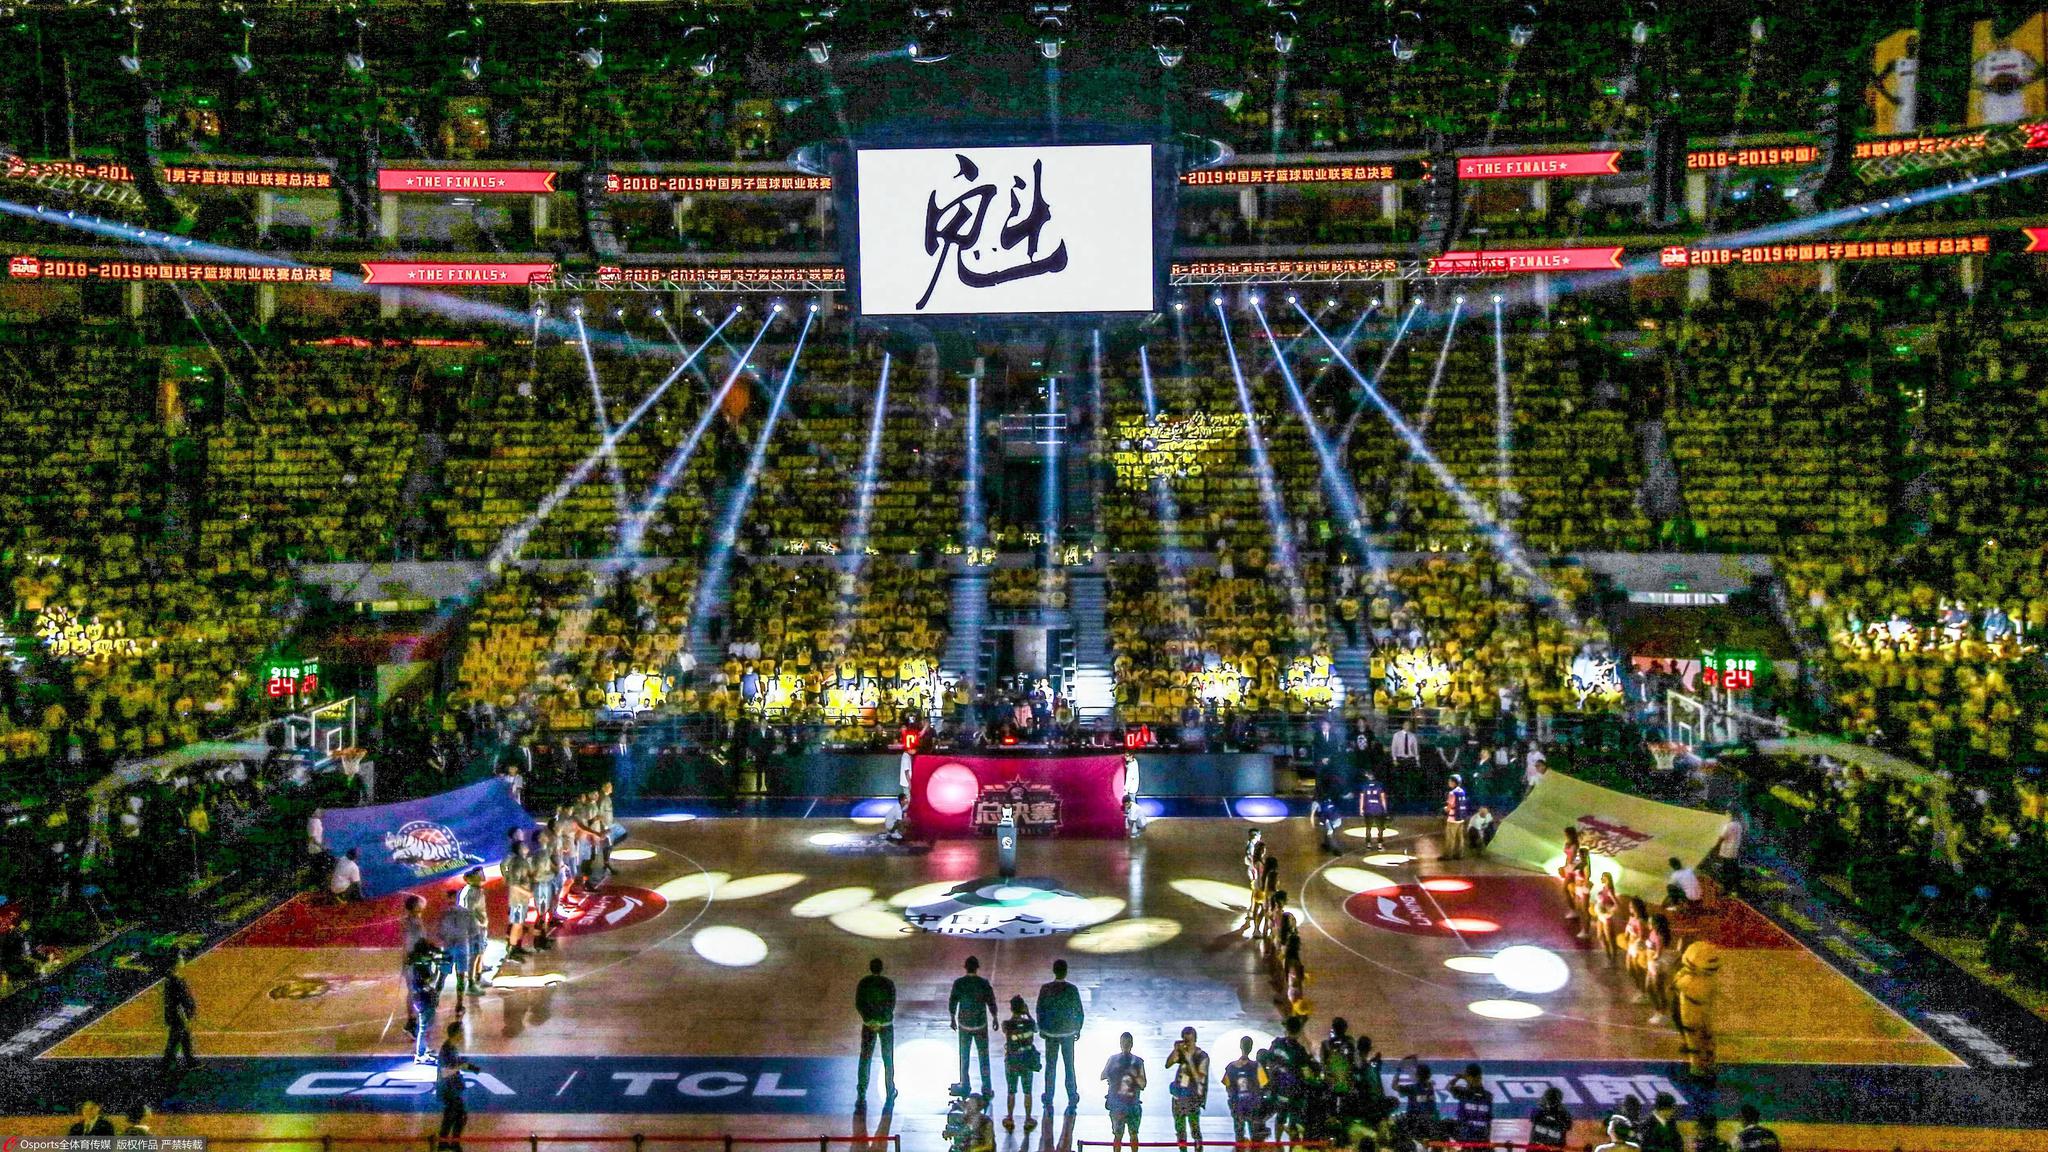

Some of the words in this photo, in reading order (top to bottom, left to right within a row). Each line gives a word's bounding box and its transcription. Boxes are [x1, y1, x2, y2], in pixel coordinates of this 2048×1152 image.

[1476, 163, 1502, 174] THE
[1507, 160, 1558, 173] FINALS
[416, 176, 442, 187] THE
[446, 177, 496, 188] FINALS
[1509, 255, 1561, 267] FINALS
[418, 269, 443, 281] THE
[448, 269, 498, 281] FINALS
[1725, 670, 1751, 688] 24
[270, 677, 294, 695] 24
[899, 927, 1005, 935] CHINA
[611, 1071, 808, 1097] TCL
